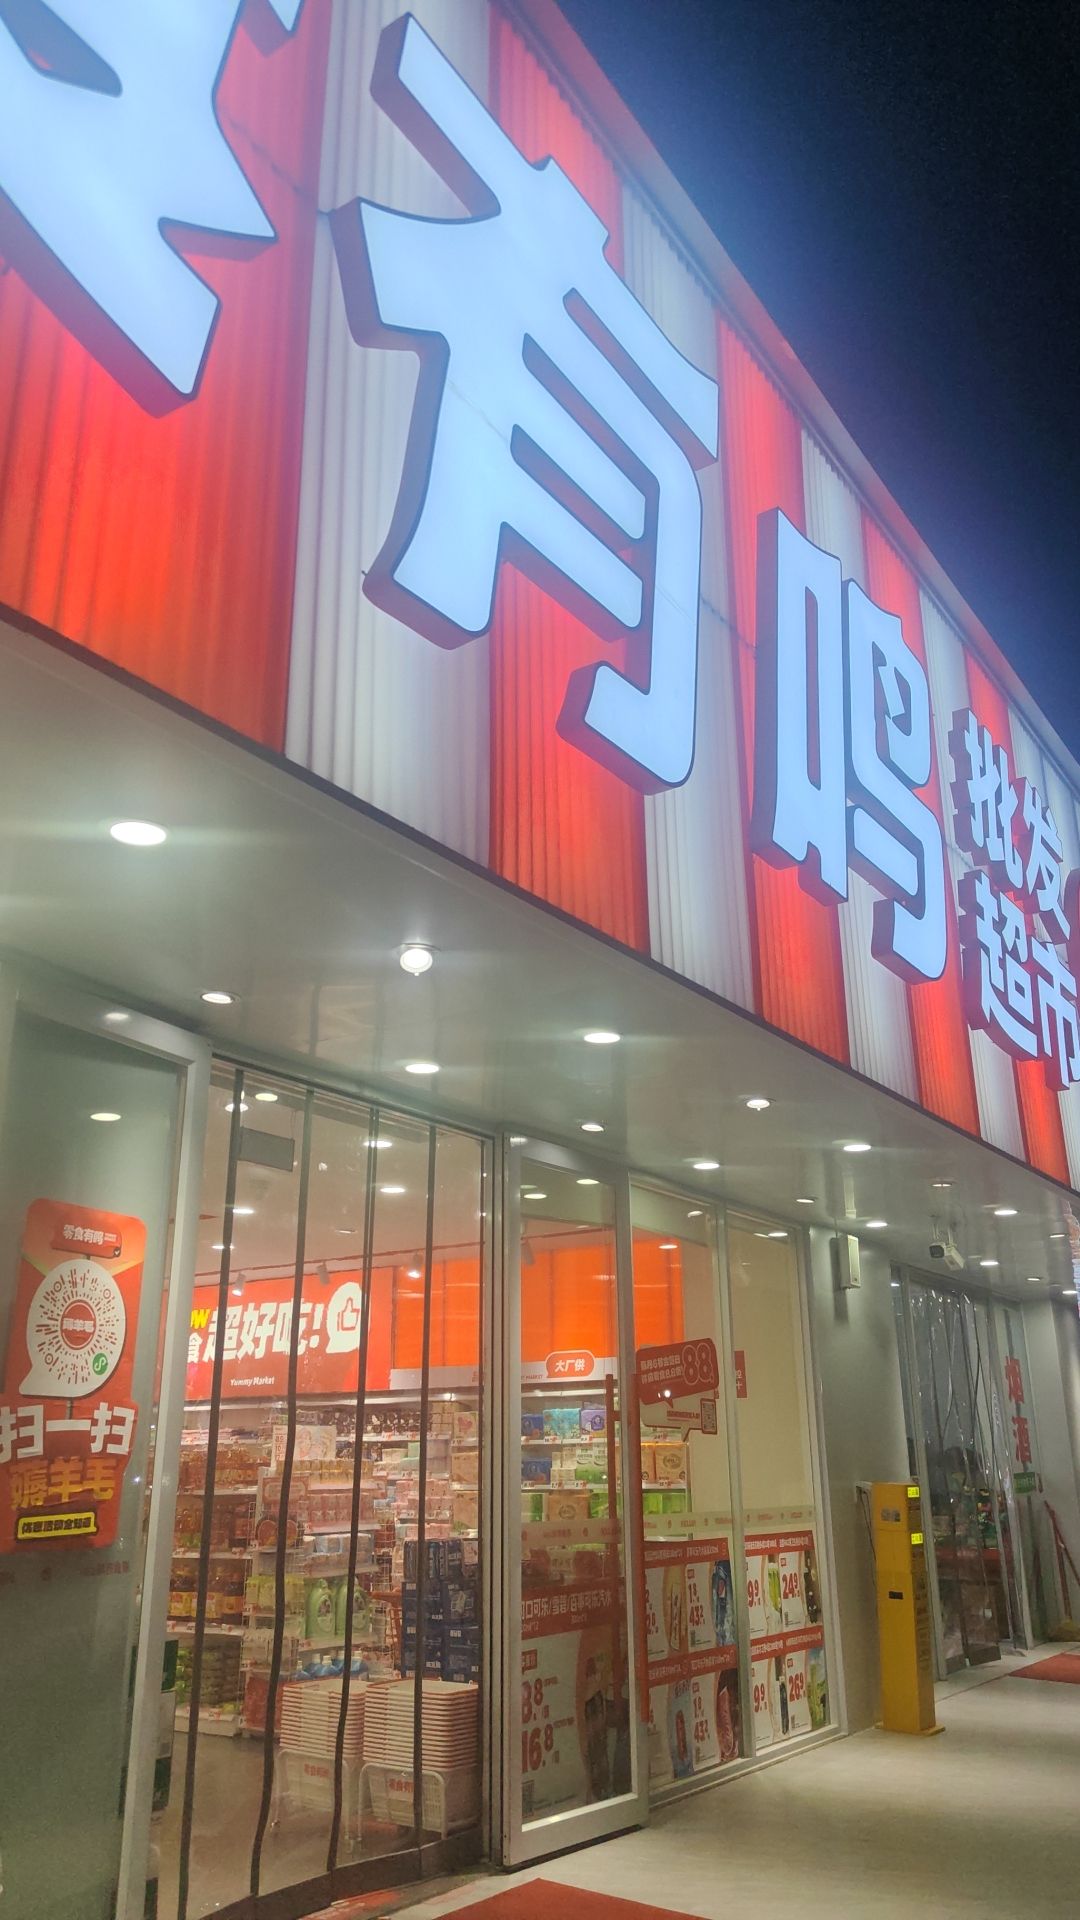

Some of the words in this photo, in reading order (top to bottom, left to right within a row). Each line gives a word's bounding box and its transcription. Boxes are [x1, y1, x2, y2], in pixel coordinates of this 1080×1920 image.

[960, 708, 1071, 941] 批发
[972, 870, 1080, 1090] 超市
[0, 1402, 135, 1464] 扫一扫
[230, 1378, 253, 1387] Yummy
[253, 1376, 275, 1386] Market
